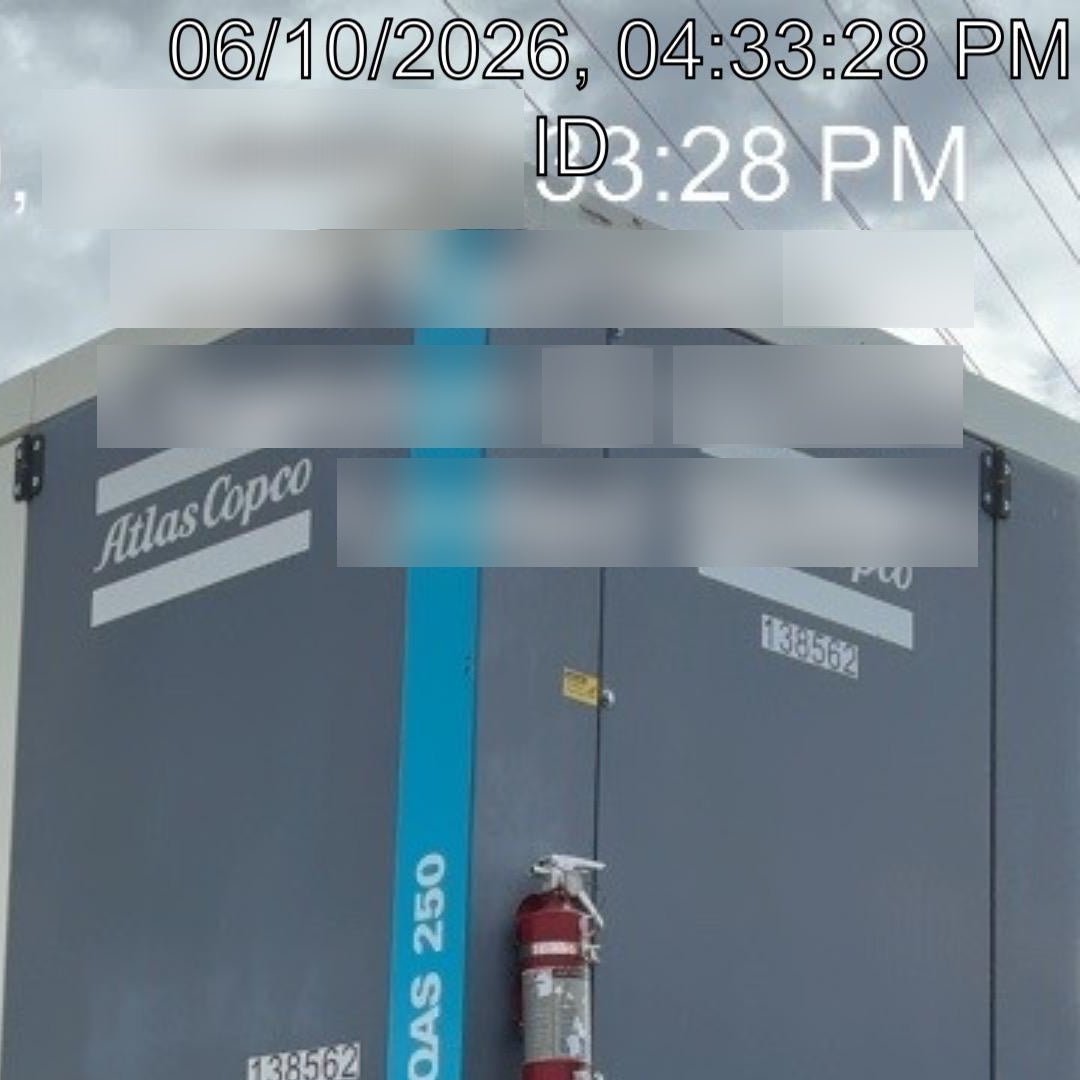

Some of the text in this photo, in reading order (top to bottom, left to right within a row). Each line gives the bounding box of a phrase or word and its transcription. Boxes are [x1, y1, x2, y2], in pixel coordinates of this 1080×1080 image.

[94, 457, 313, 573] Atlas Copco
[762, 614, 859, 680] 138562
[413, 853, 446, 955] 250
